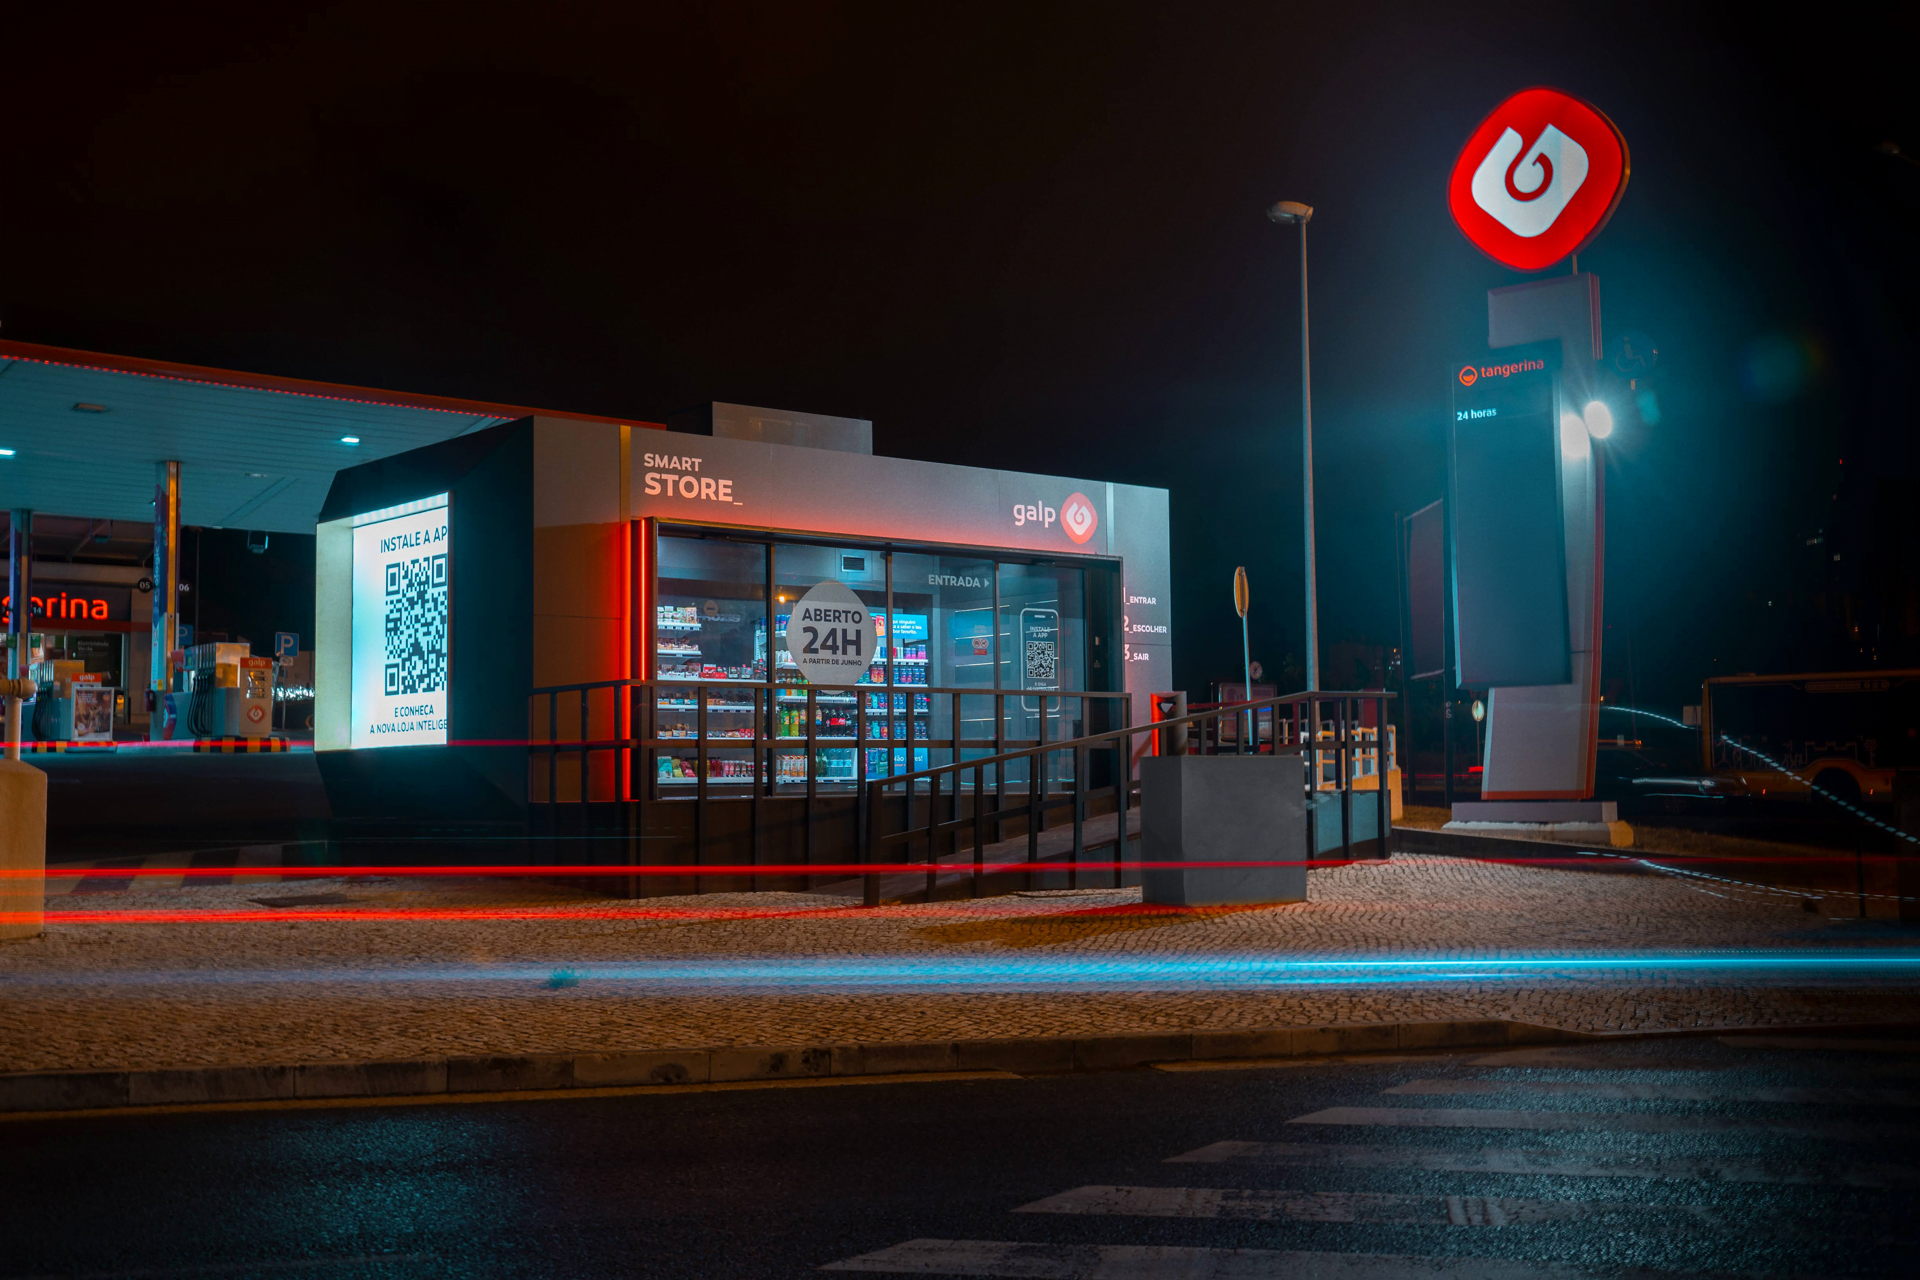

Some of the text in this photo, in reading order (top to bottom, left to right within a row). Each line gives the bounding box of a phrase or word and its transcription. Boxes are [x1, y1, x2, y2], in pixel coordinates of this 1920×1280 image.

[1481, 359, 1544, 378] tangerina
[1456, 407, 1497, 421] 24 horas
[644, 453, 702, 472] SMART
[644, 472, 743, 506] STORE_
[1013, 500, 1057, 528] galp
[380, 531, 421, 553] INSTALE
[423, 529, 431, 545] A
[140, 581, 150, 589] 05
[178, 583, 190, 591] 06
[928, 574, 981, 588] ENTRADA
[32, 606, 42, 615] 14
[802, 608, 863, 624] ABERTO
[1029, 625, 1051, 633] INSTALE
[281, 634, 294, 652] P
[802, 626, 862, 656] 24H
[248, 658, 266, 667] galp
[79, 673, 95, 682] galp
[394, 704, 434, 719] E CONHEÇA
[370, 724, 375, 734] A
[376, 723, 396, 734] NOVA
[397, 721, 415, 732] LOJA
